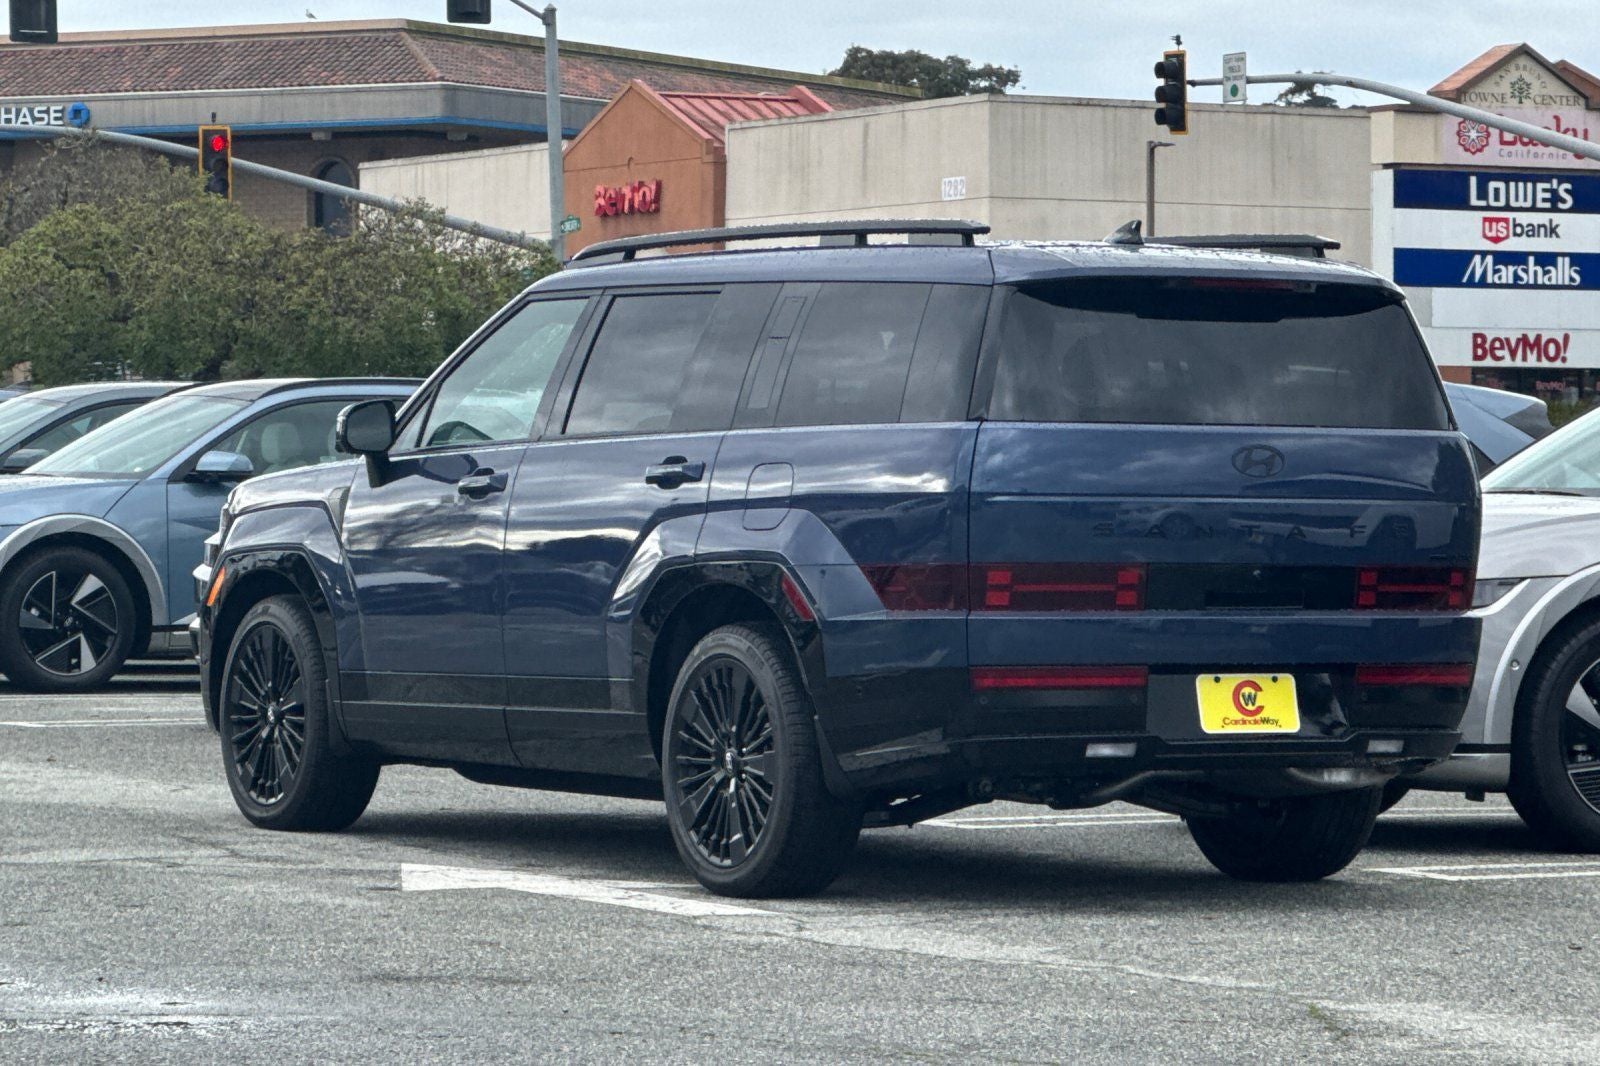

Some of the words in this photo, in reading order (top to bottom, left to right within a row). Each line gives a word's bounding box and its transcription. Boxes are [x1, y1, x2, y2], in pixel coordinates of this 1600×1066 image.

[1462, 92, 1508, 104] TOWNE
[1533, 94, 1581, 106] CENTER
[0, 106, 63, 126] HASE
[1469, 175, 1573, 210] LOWE'S
[1462, 254, 1581, 286] Marshalls
[1472, 332, 1571, 364] BevMo!
